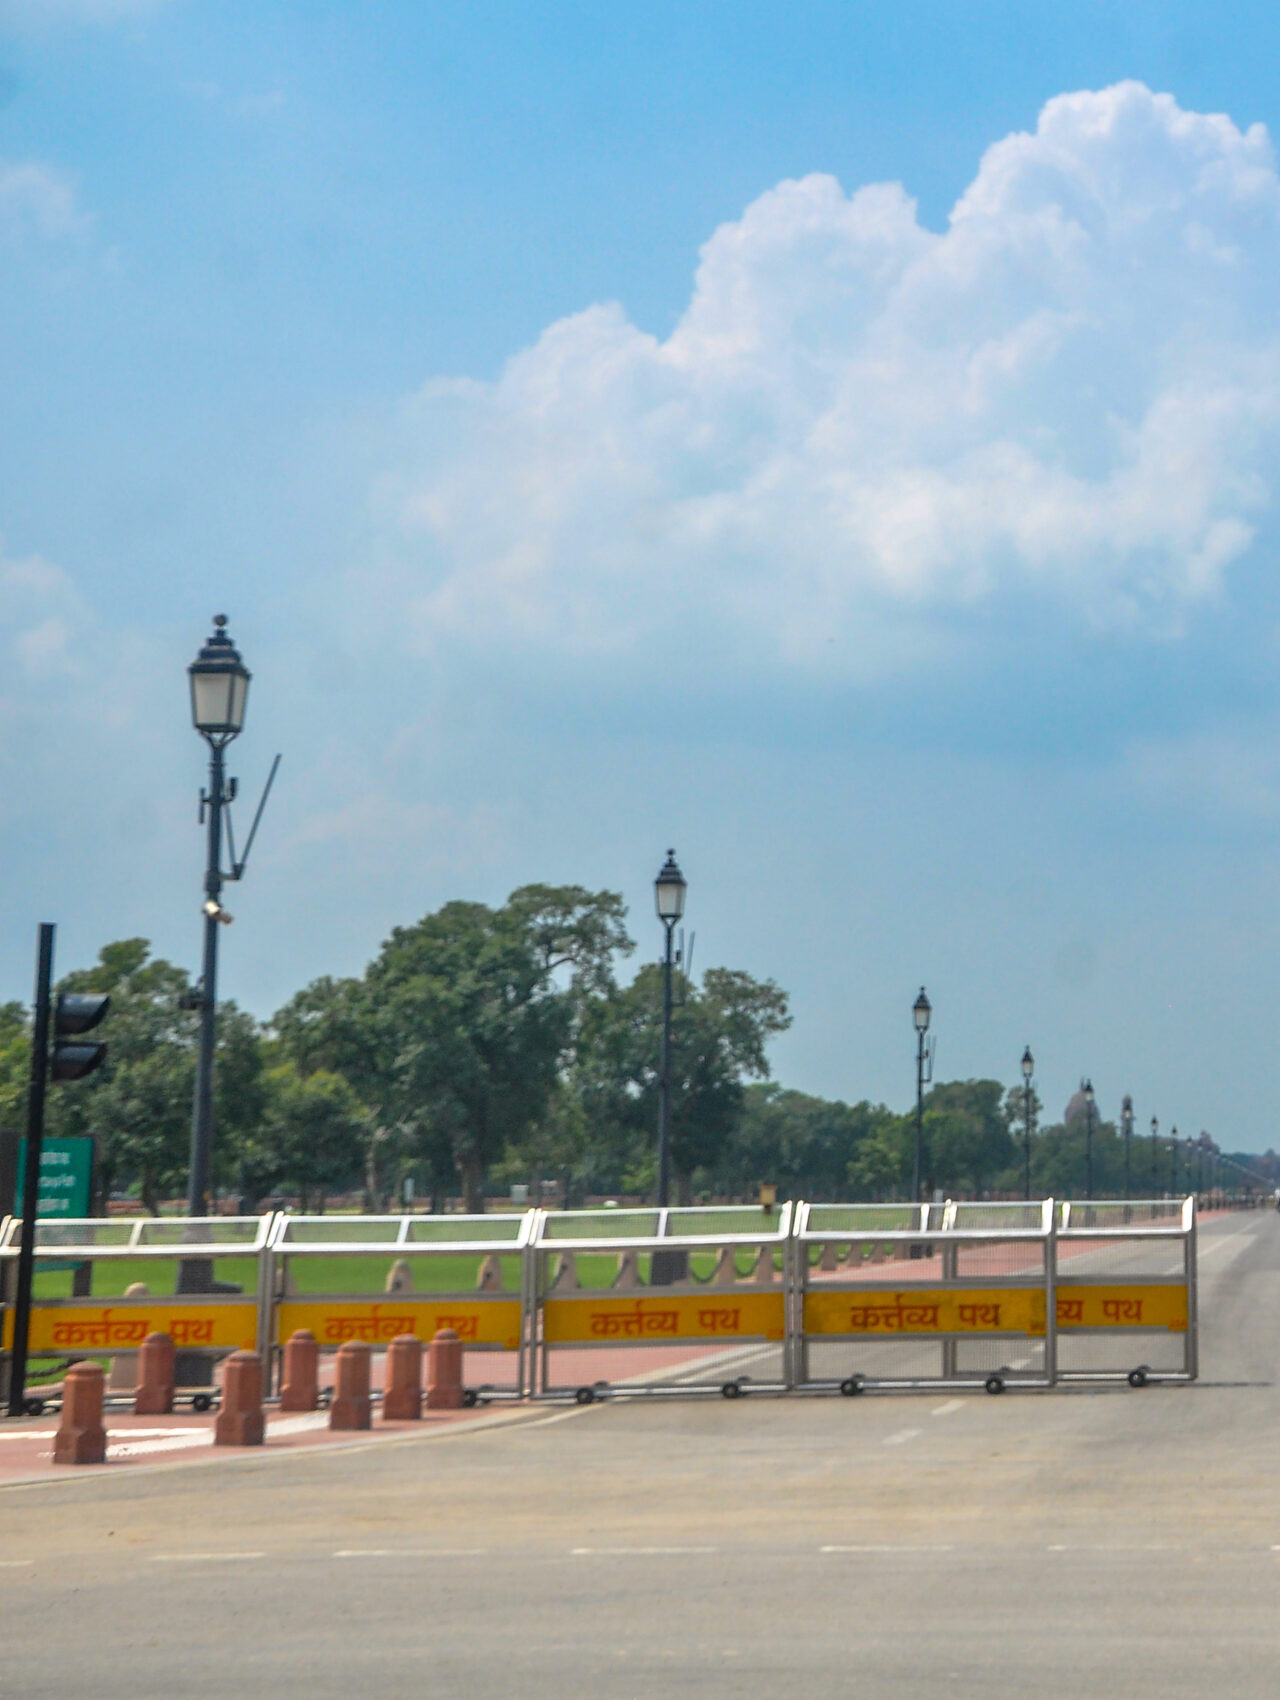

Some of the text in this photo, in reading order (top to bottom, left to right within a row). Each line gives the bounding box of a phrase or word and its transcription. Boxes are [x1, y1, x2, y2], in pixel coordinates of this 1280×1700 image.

[698, 1308, 740, 1331] पथ
[958, 1303, 1000, 1326] पथ
[1102, 1299, 1143, 1322] पथ
